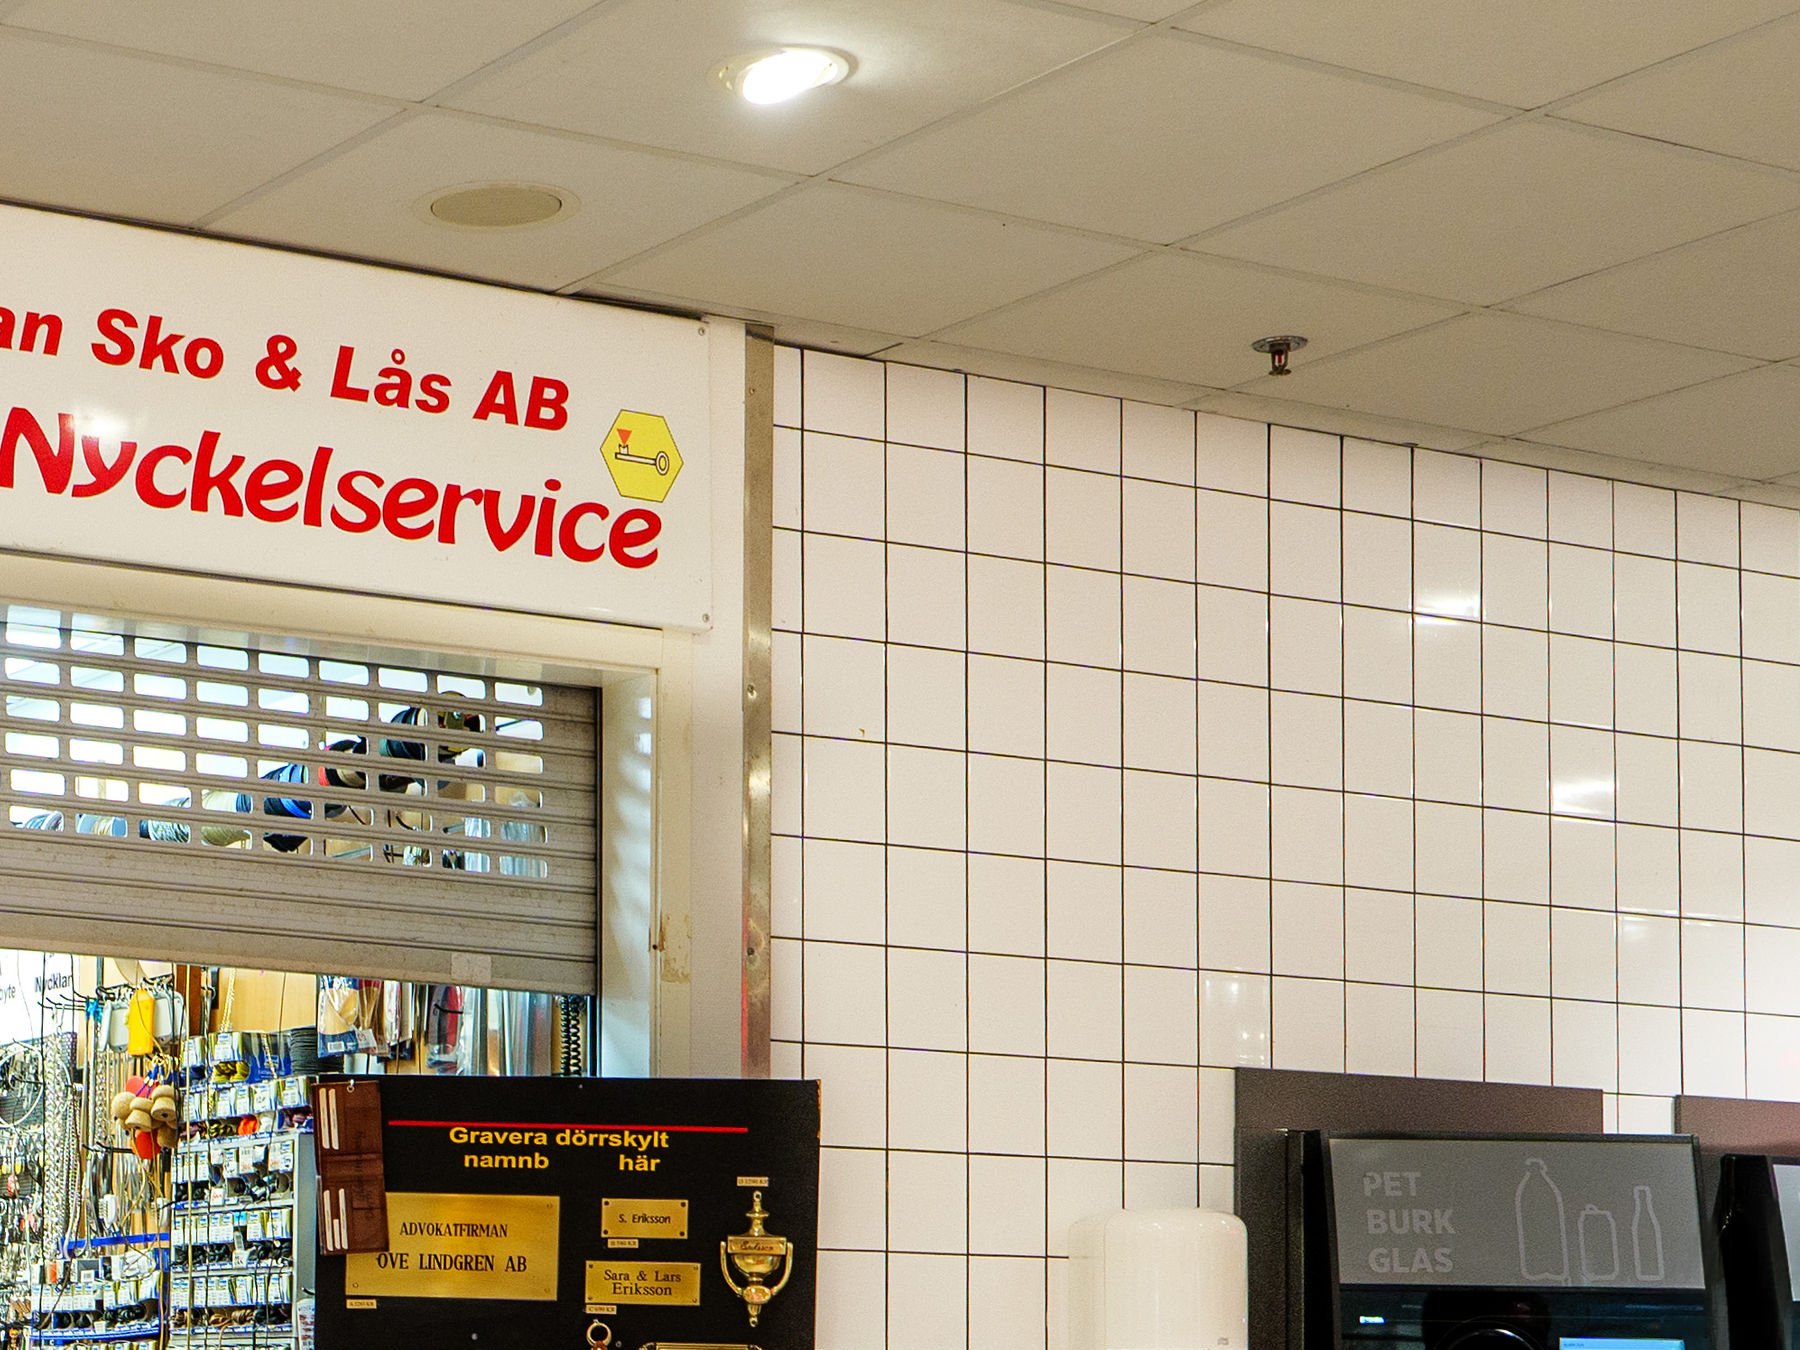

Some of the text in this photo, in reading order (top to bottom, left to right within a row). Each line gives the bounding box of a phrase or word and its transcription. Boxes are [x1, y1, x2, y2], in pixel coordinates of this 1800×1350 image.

[91, 308, 224, 380] Sko
[255, 334, 303, 393] &
[331, 345, 452, 414] Lås
[474, 370, 570, 432] AB
[449, 1126, 670, 1151] Gravera dörrskylt
[463, 1151, 661, 1173] namnb här
[1362, 1170, 1422, 1197] PET
[399, 1221, 509, 1239] ADVOKATFIRMAN
[618, 1213, 671, 1225] S. Eriksson
[1366, 1208, 1457, 1235] BURK
[376, 1252, 528, 1273] OVE LINDGREN AB
[1368, 1247, 1454, 1274] GLAS
[603, 1269, 682, 1283] Sara & Lars
[611, 1282, 673, 1297] Eriksson
